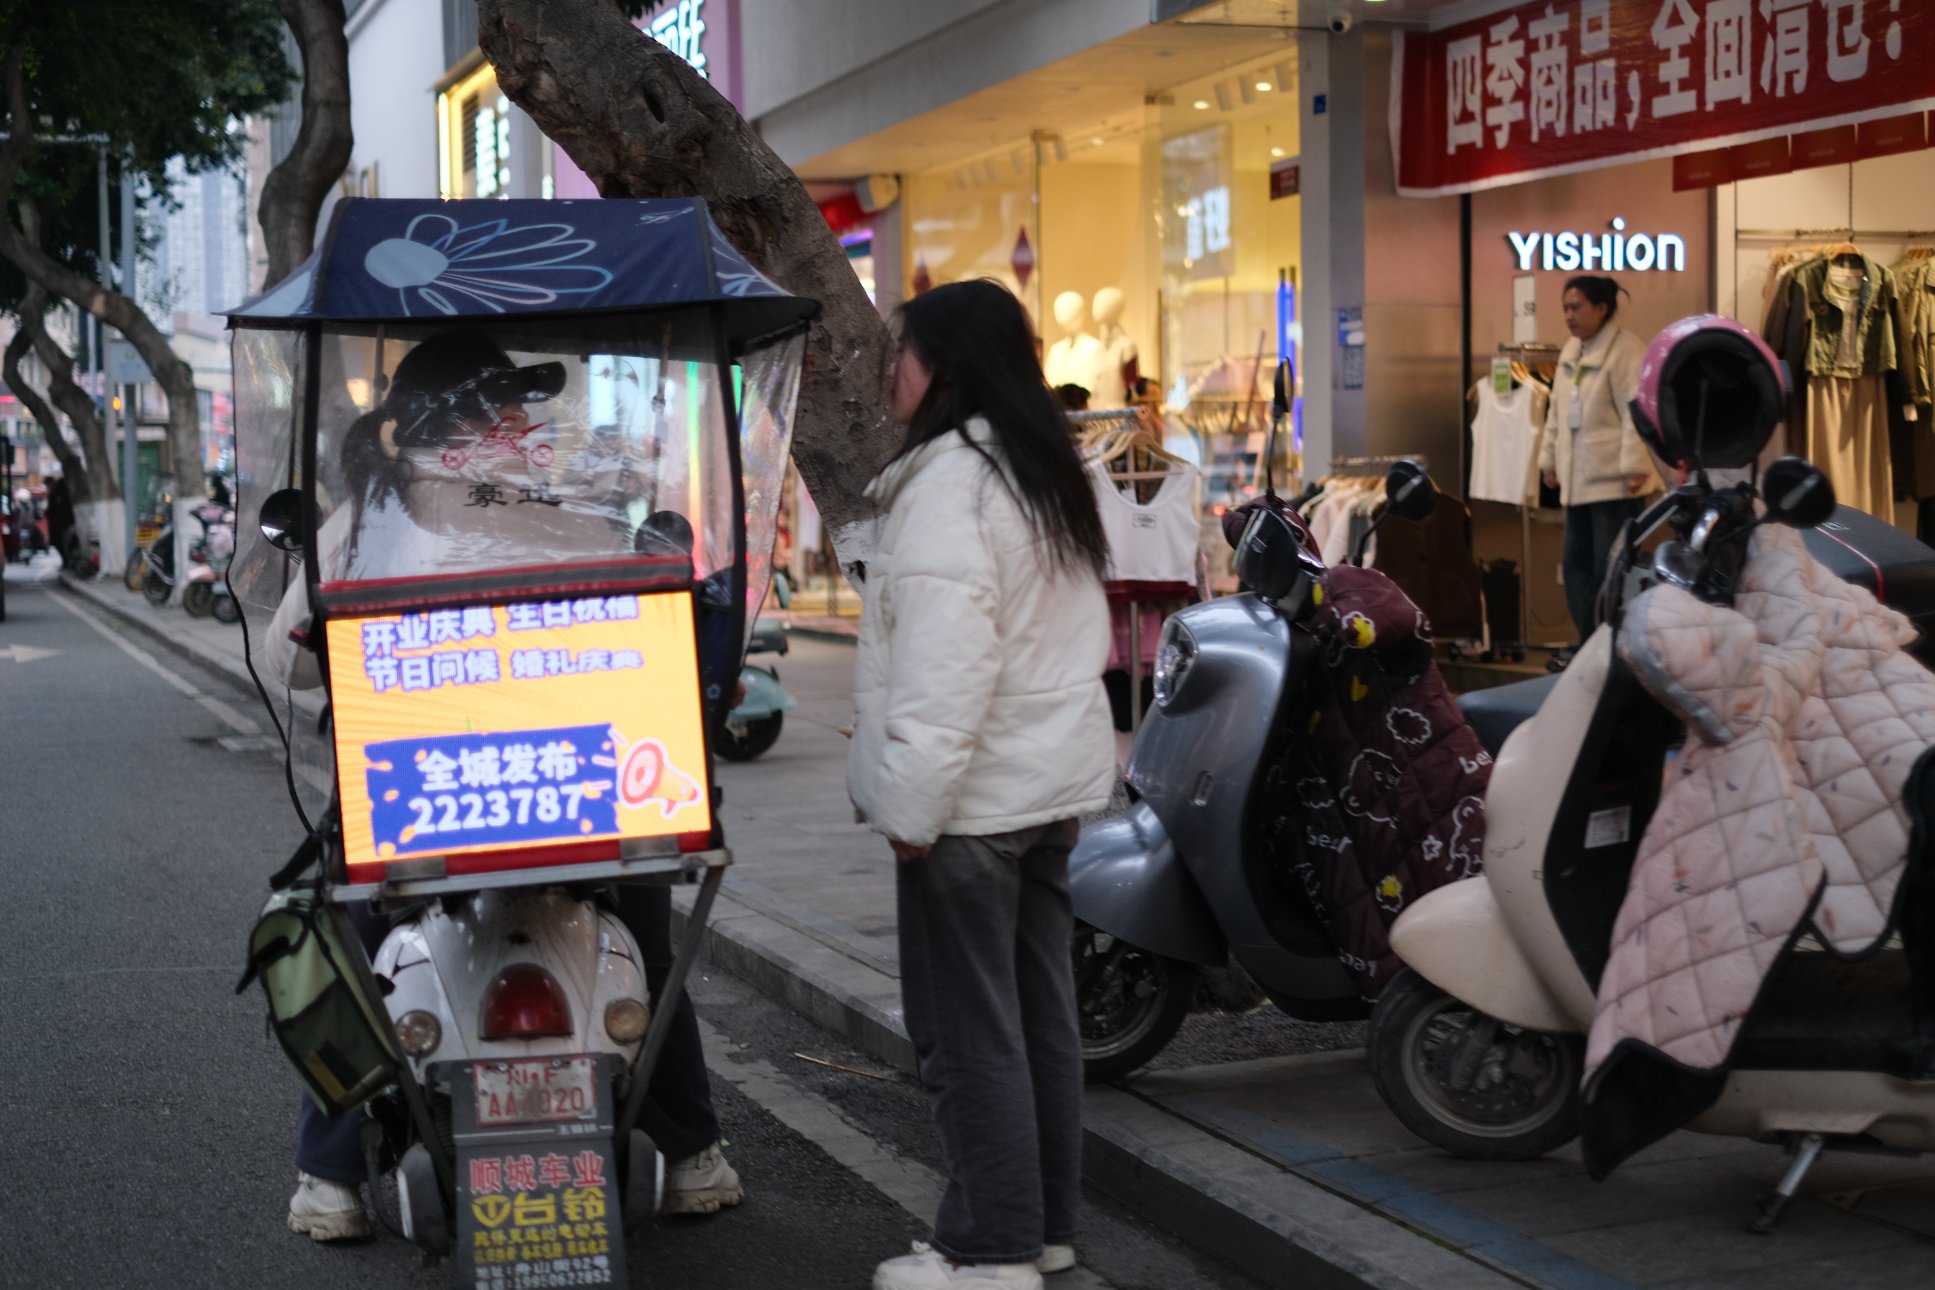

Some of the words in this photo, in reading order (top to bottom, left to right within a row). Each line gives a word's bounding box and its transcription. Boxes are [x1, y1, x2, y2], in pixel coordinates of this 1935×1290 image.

[362, 606, 496, 657] 开业庆典
[507, 596, 639, 627] 生日祝福
[364, 649, 501, 693] 节日问候
[510, 650, 643, 678] 婚礼庆典
[416, 742, 577, 791] 全城发布
[408, 784, 584, 835] 2223787
[488, 1087, 585, 1117] AA020
[469, 1151, 606, 1193] 顺城车业
[513, 1187, 606, 1226] 台铃
